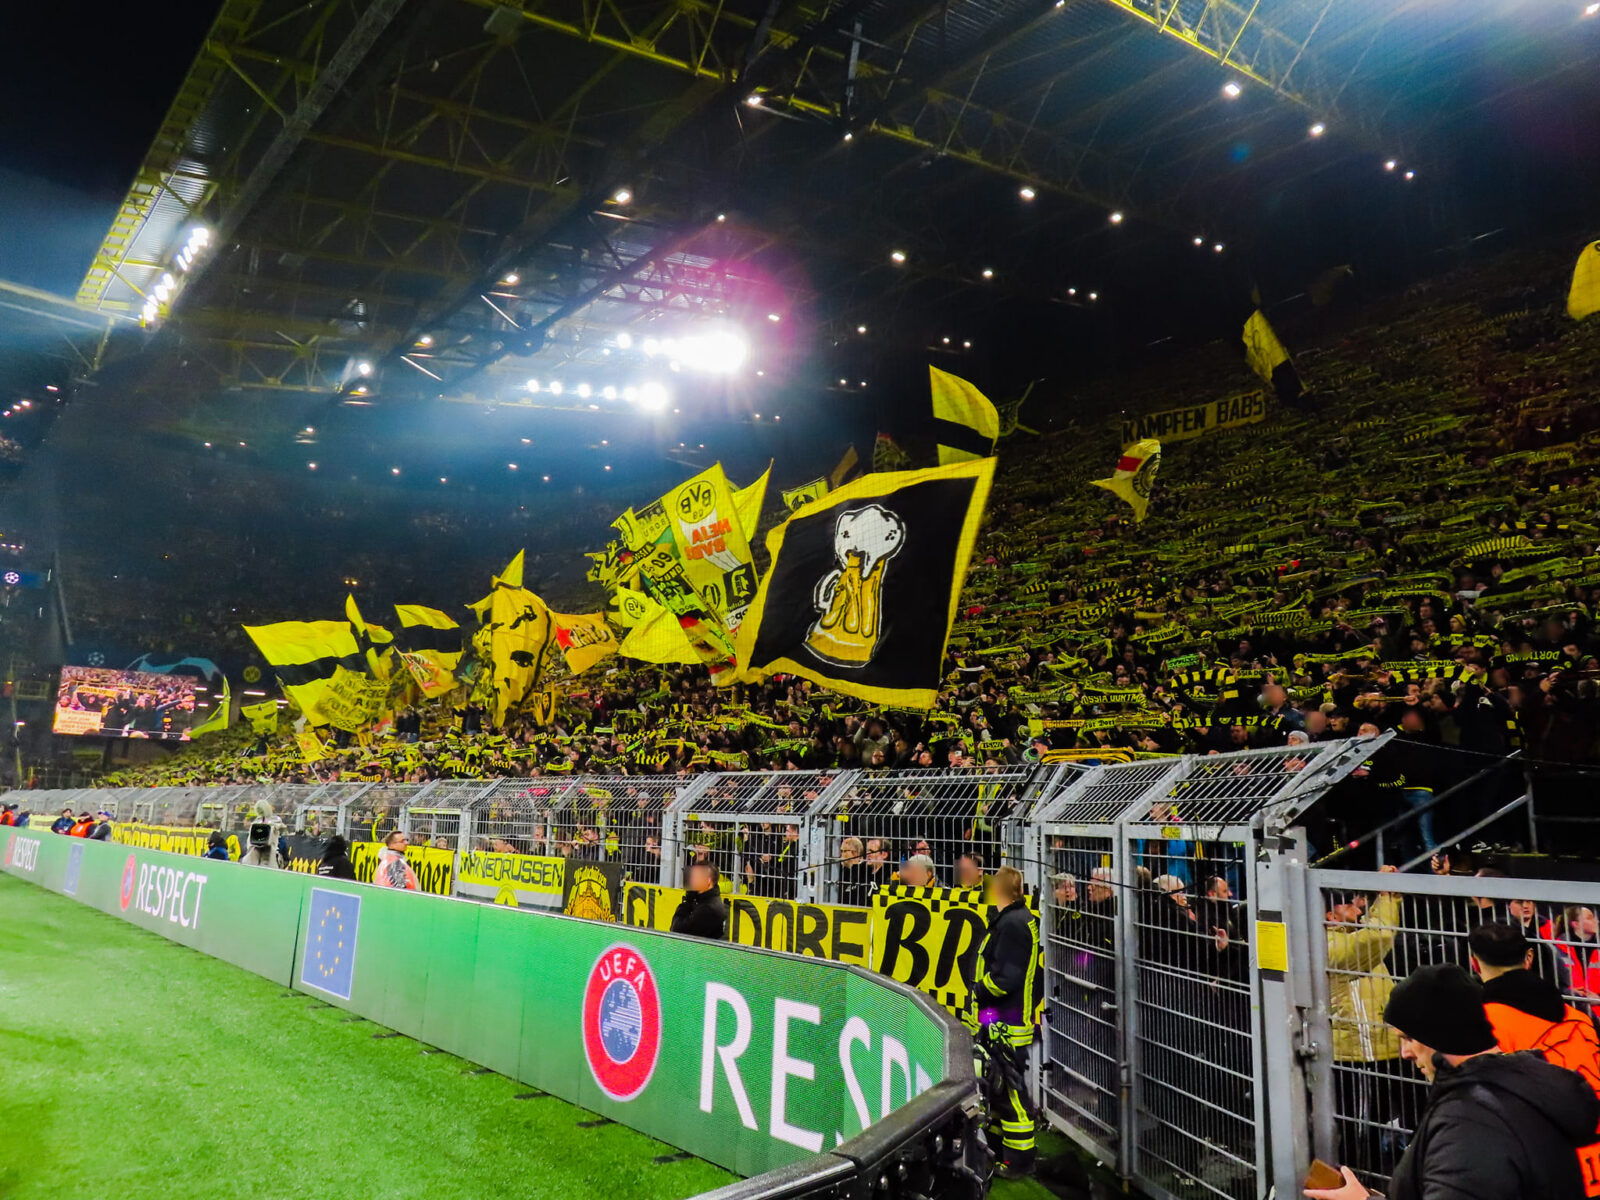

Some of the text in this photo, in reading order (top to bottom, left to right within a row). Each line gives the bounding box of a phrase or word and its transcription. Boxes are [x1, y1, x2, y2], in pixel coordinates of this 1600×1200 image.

[12, 836, 41, 872] RESPECT
[136, 863, 208, 929] RESPECT
[600, 953, 646, 992] UEFA
